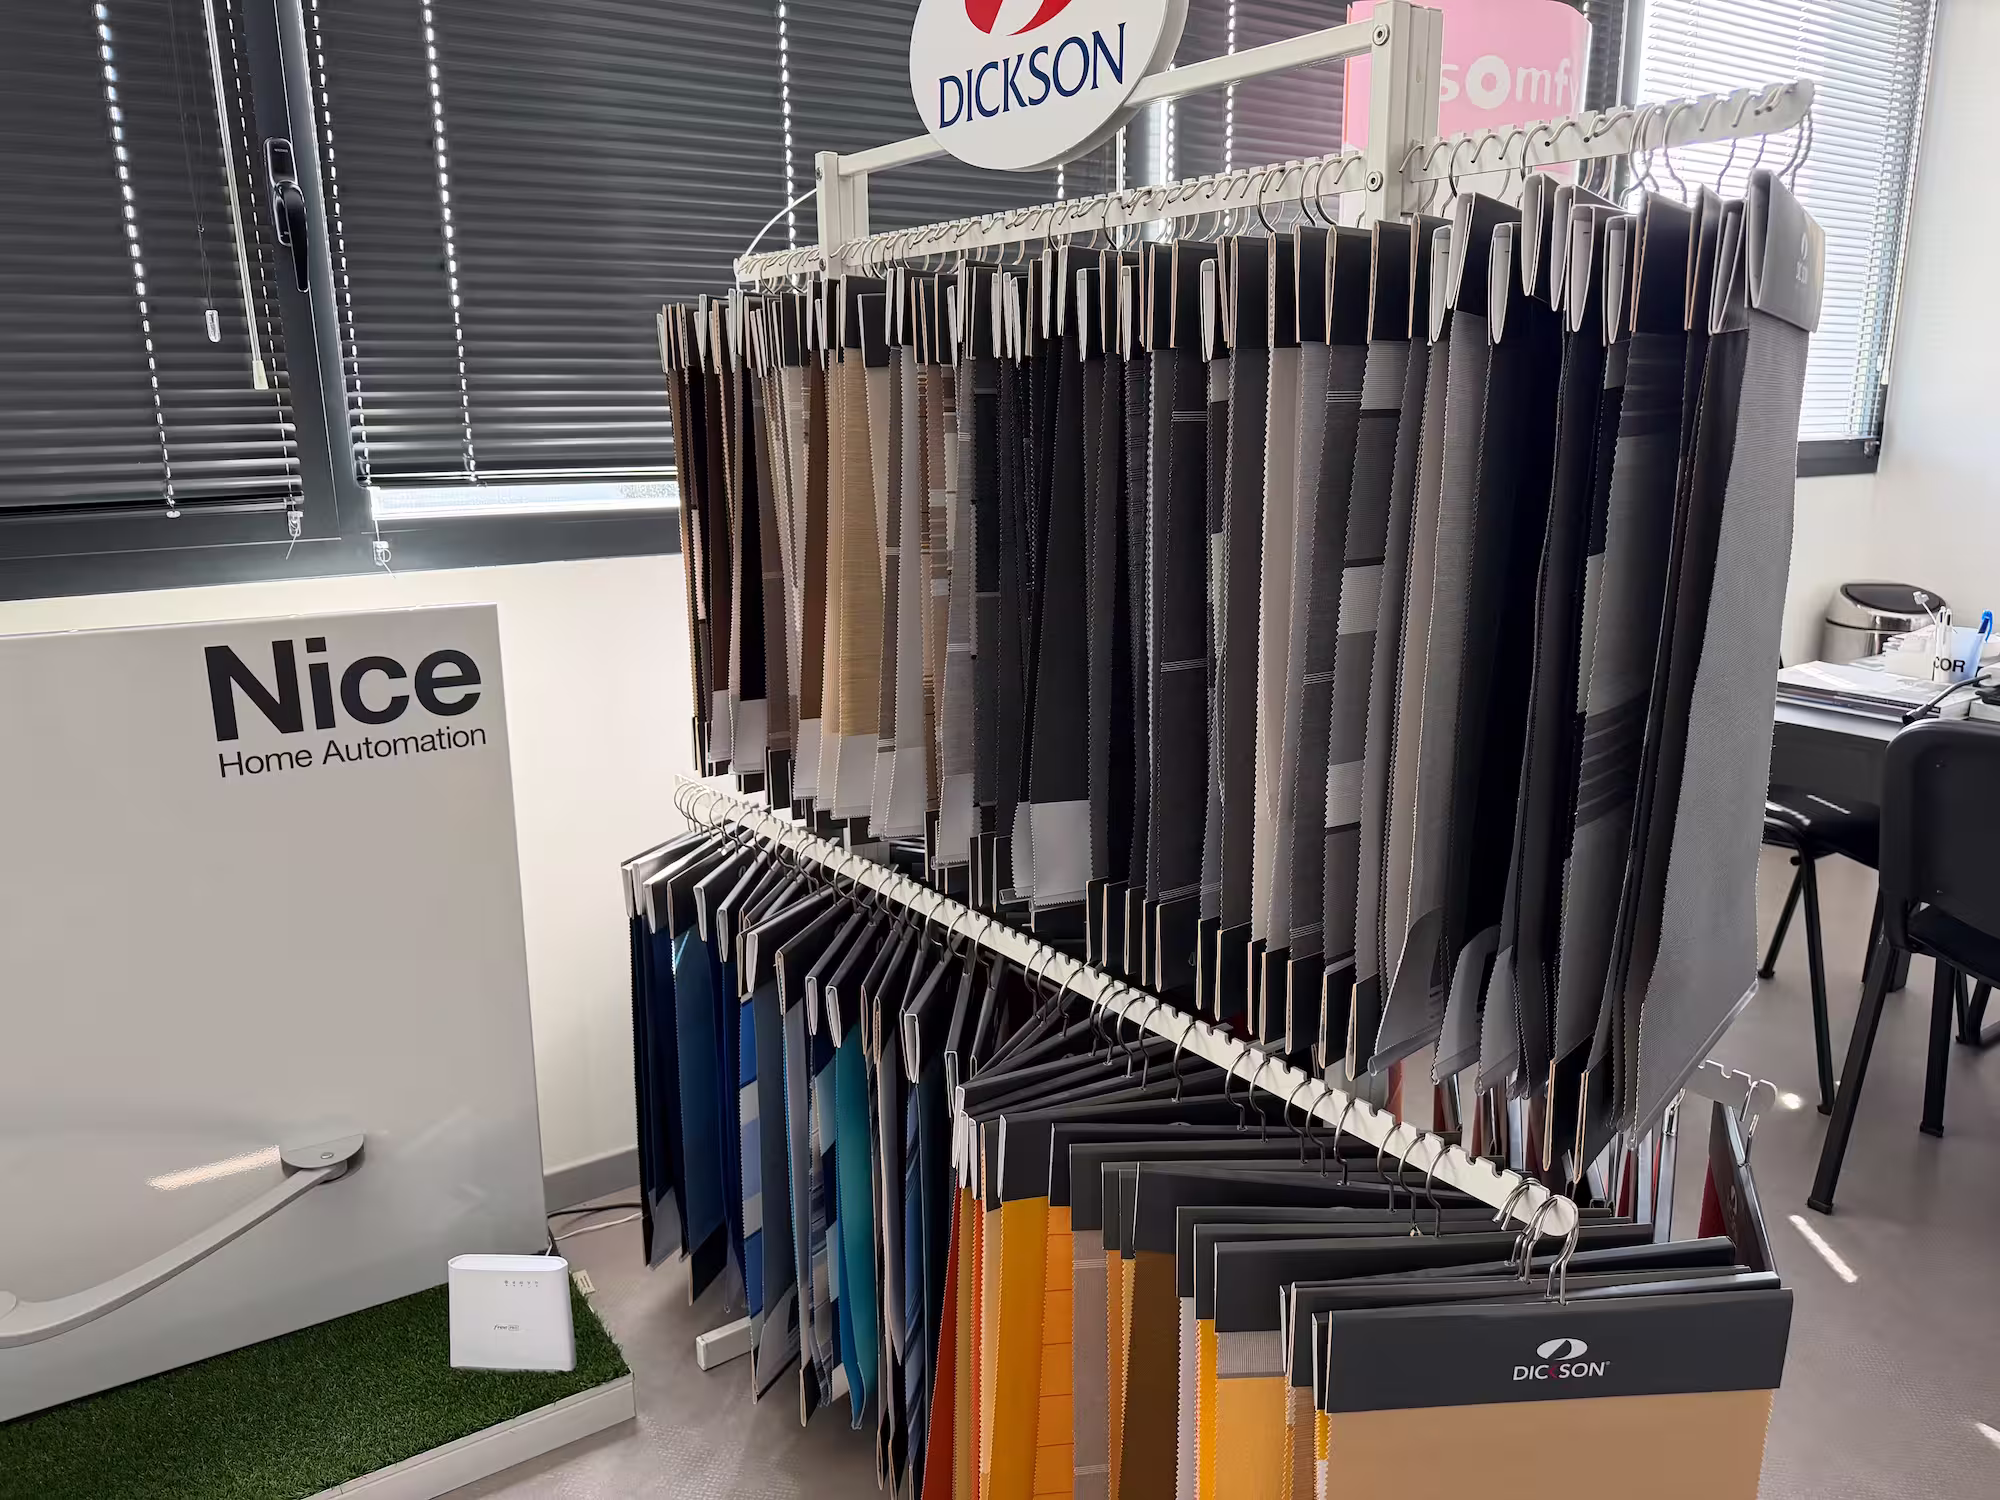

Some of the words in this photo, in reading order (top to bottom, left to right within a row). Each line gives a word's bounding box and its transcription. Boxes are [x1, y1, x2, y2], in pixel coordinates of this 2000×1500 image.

[939, 22, 1126, 129] DICKSON
[204, 637, 481, 741] Nice
[218, 749, 313, 777] Home
[322, 726, 487, 764] Automation
